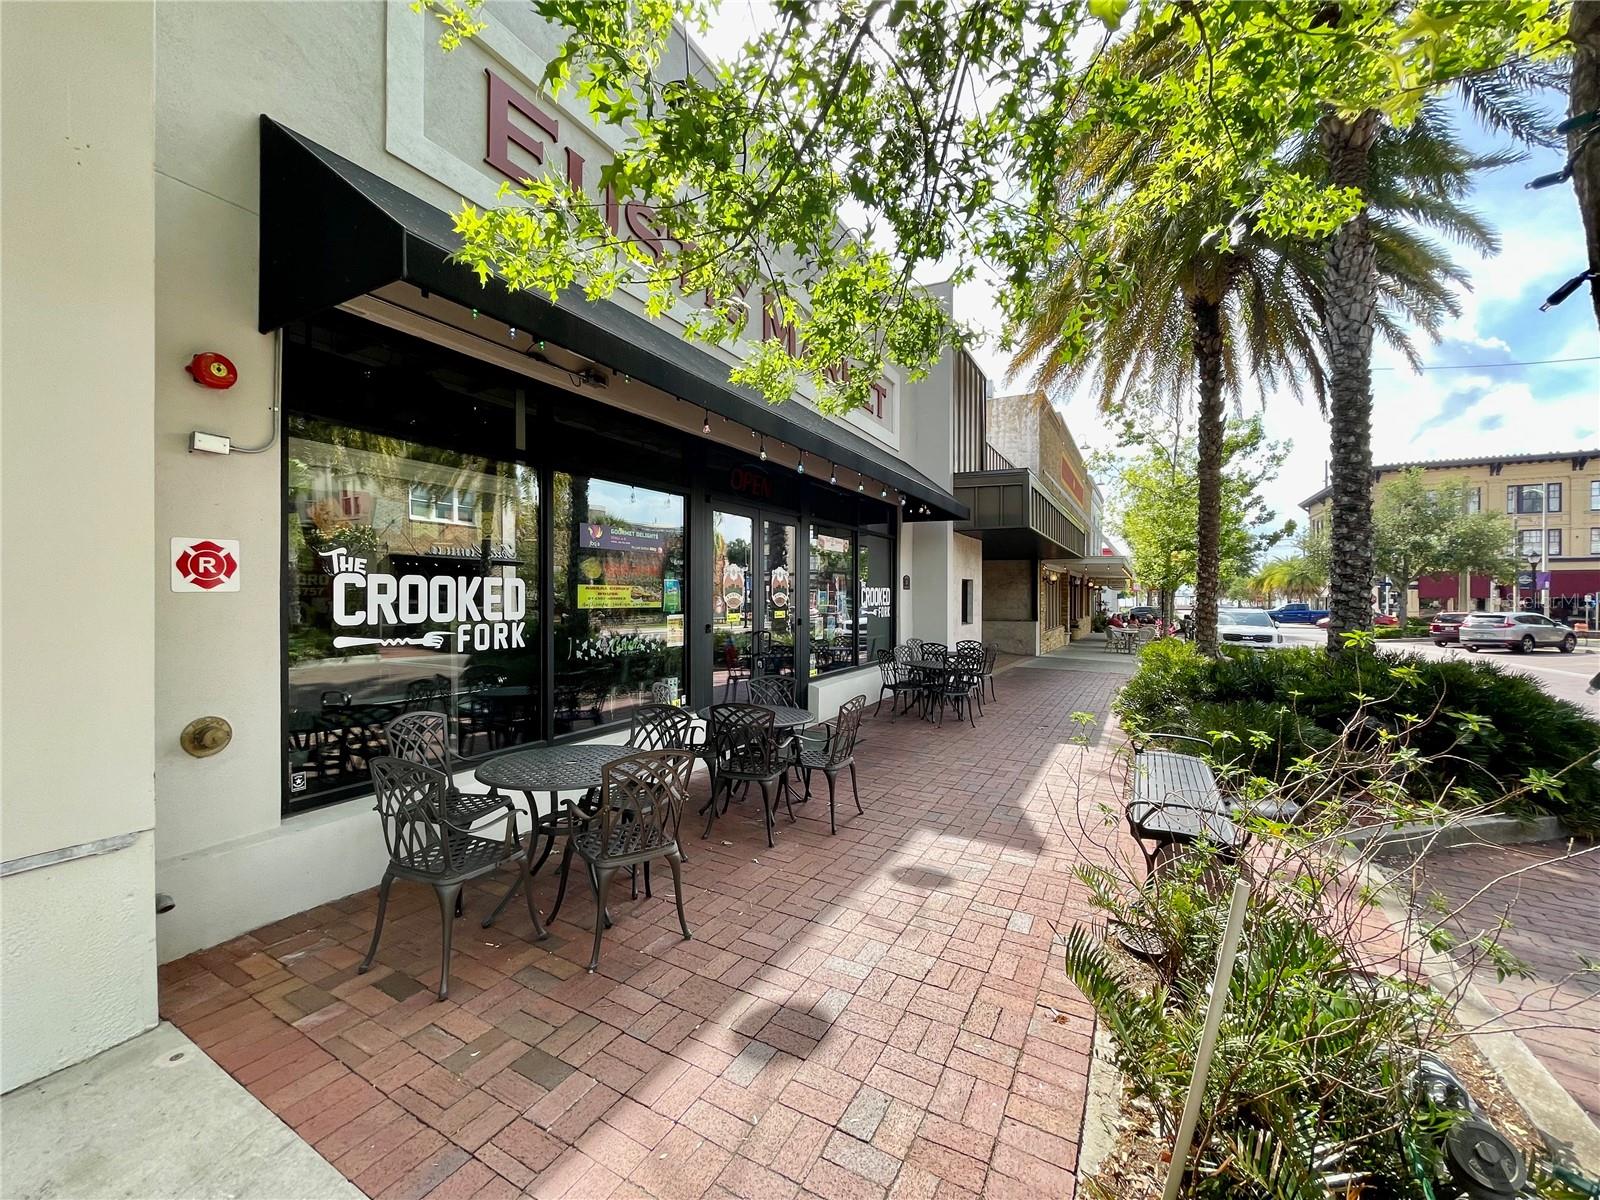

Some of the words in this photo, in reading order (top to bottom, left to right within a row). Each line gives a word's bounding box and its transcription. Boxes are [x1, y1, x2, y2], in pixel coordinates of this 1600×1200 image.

[730, 468, 774, 498] OPEN
[610, 528, 635, 537] GOURMET
[198, 556, 217, 573] R
[319, 547, 368, 574] THE
[333, 573, 526, 627] CROOKED
[861, 587, 891, 608] CROOKED
[457, 621, 526, 653] FORK
